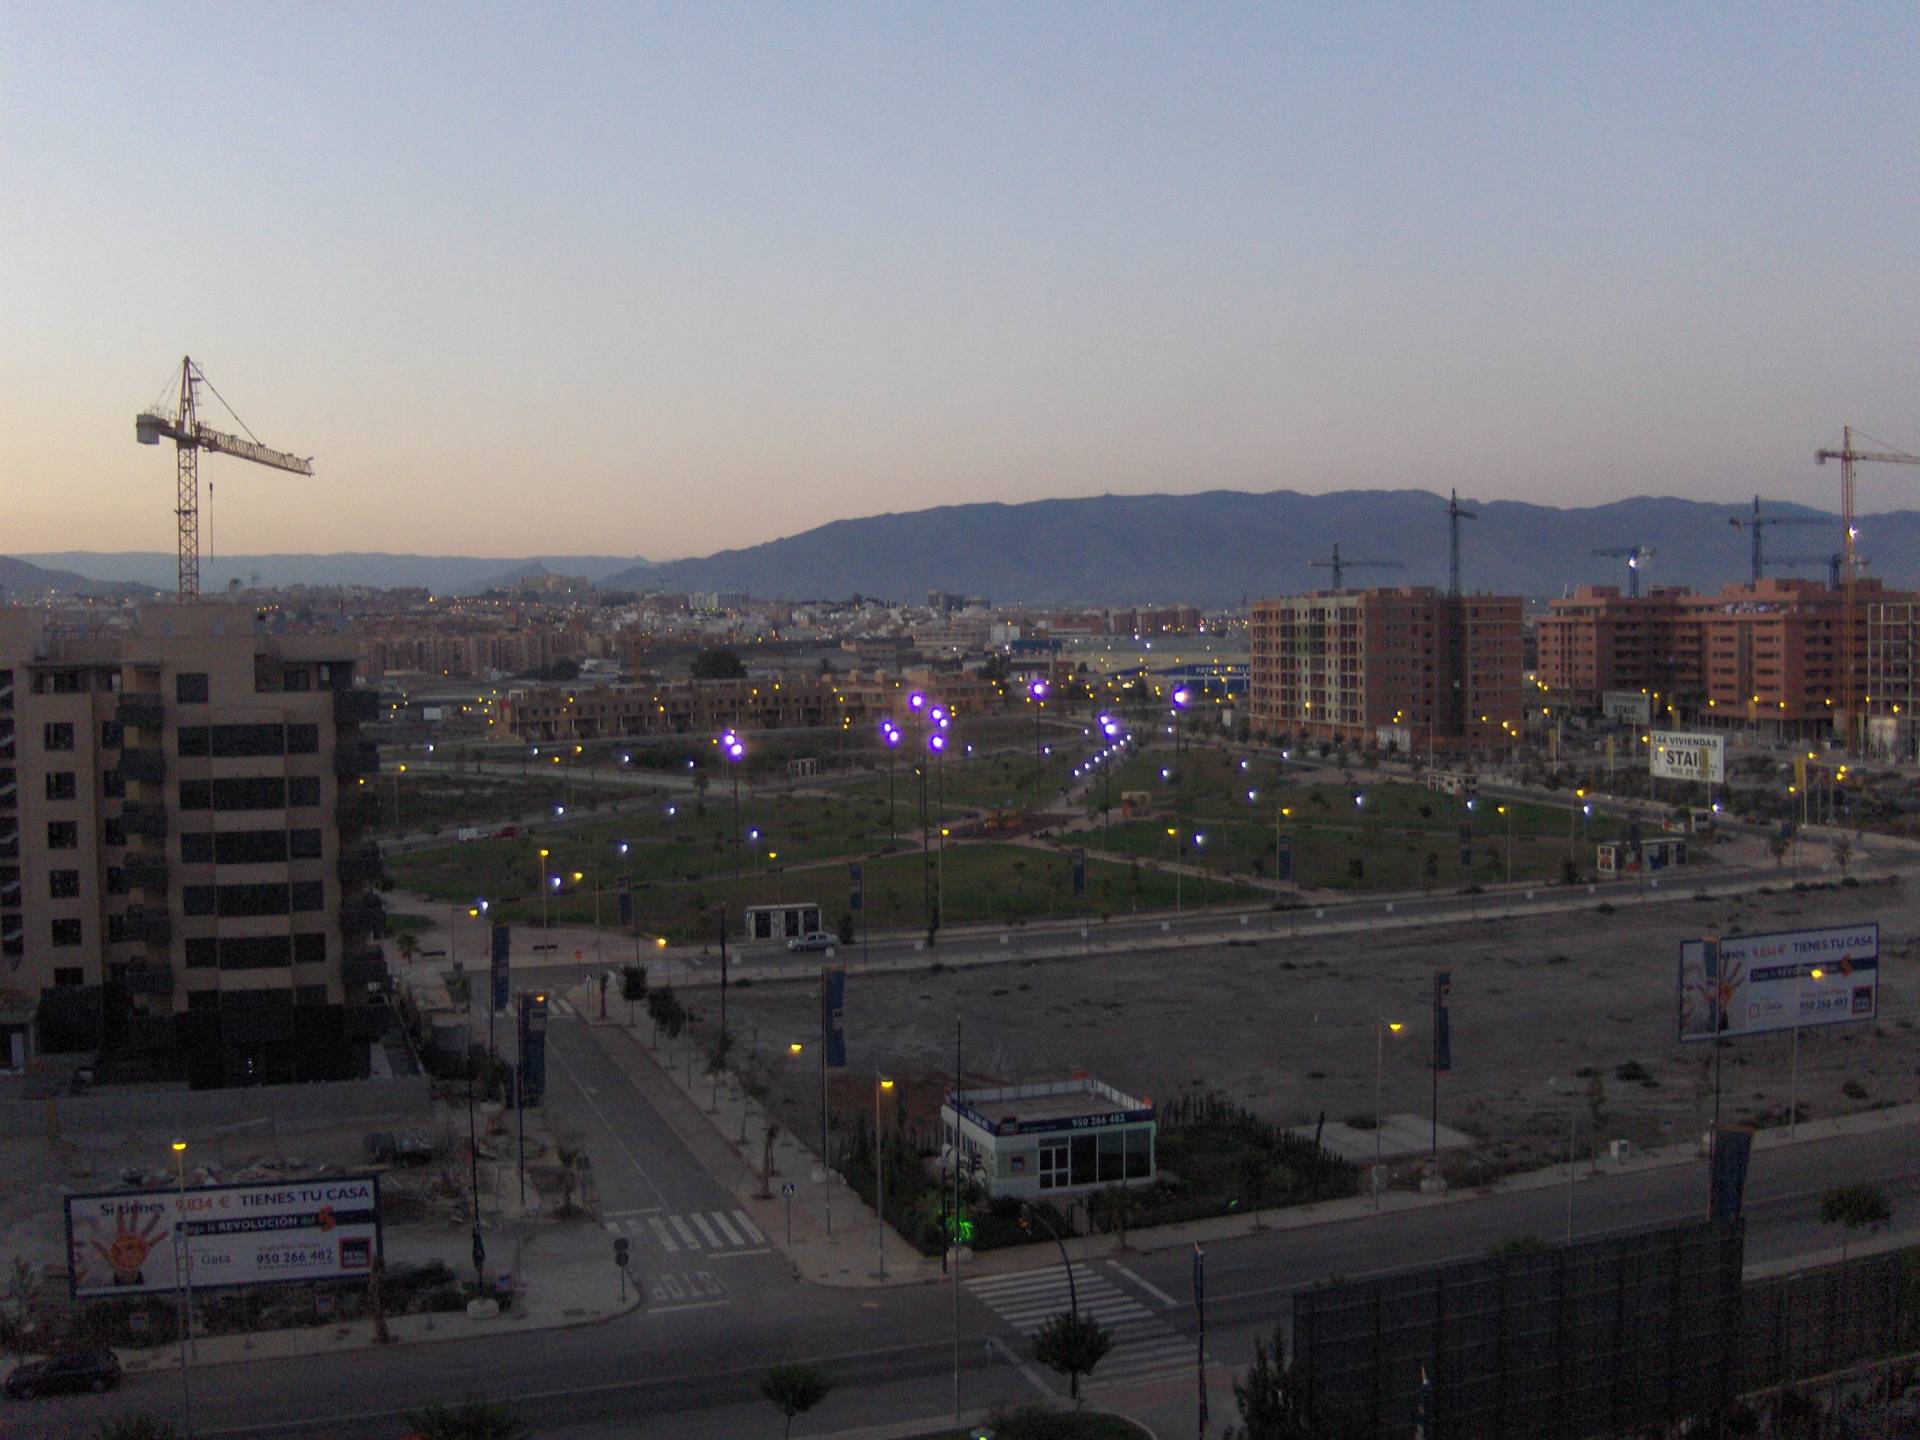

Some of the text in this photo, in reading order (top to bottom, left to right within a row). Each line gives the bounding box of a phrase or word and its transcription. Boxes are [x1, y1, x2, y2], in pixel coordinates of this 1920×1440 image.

[1670, 736, 1717, 748] VIVIENDAS
[1667, 749, 1708, 768] STAI
[1793, 938, 1829, 953] TIENES
[1830, 937, 1845, 949] TU
[1846, 935, 1873, 947] CASA
[1072, 1113, 1125, 1128] 950 266 482
[100, 1202, 114, 1217] Si
[117, 1199, 166, 1214] tienes
[219, 1195, 231, 1209] €
[240, 1190, 295, 1207] TIENES
[298, 1189, 322, 1202] TU
[326, 1186, 369, 1200] CASA
[218, 1215, 298, 1232] REVOLUCIÓN
[256, 1253, 279, 1264] 950
[283, 1250, 306, 1263] 266
[310, 1248, 333, 1261] 482
